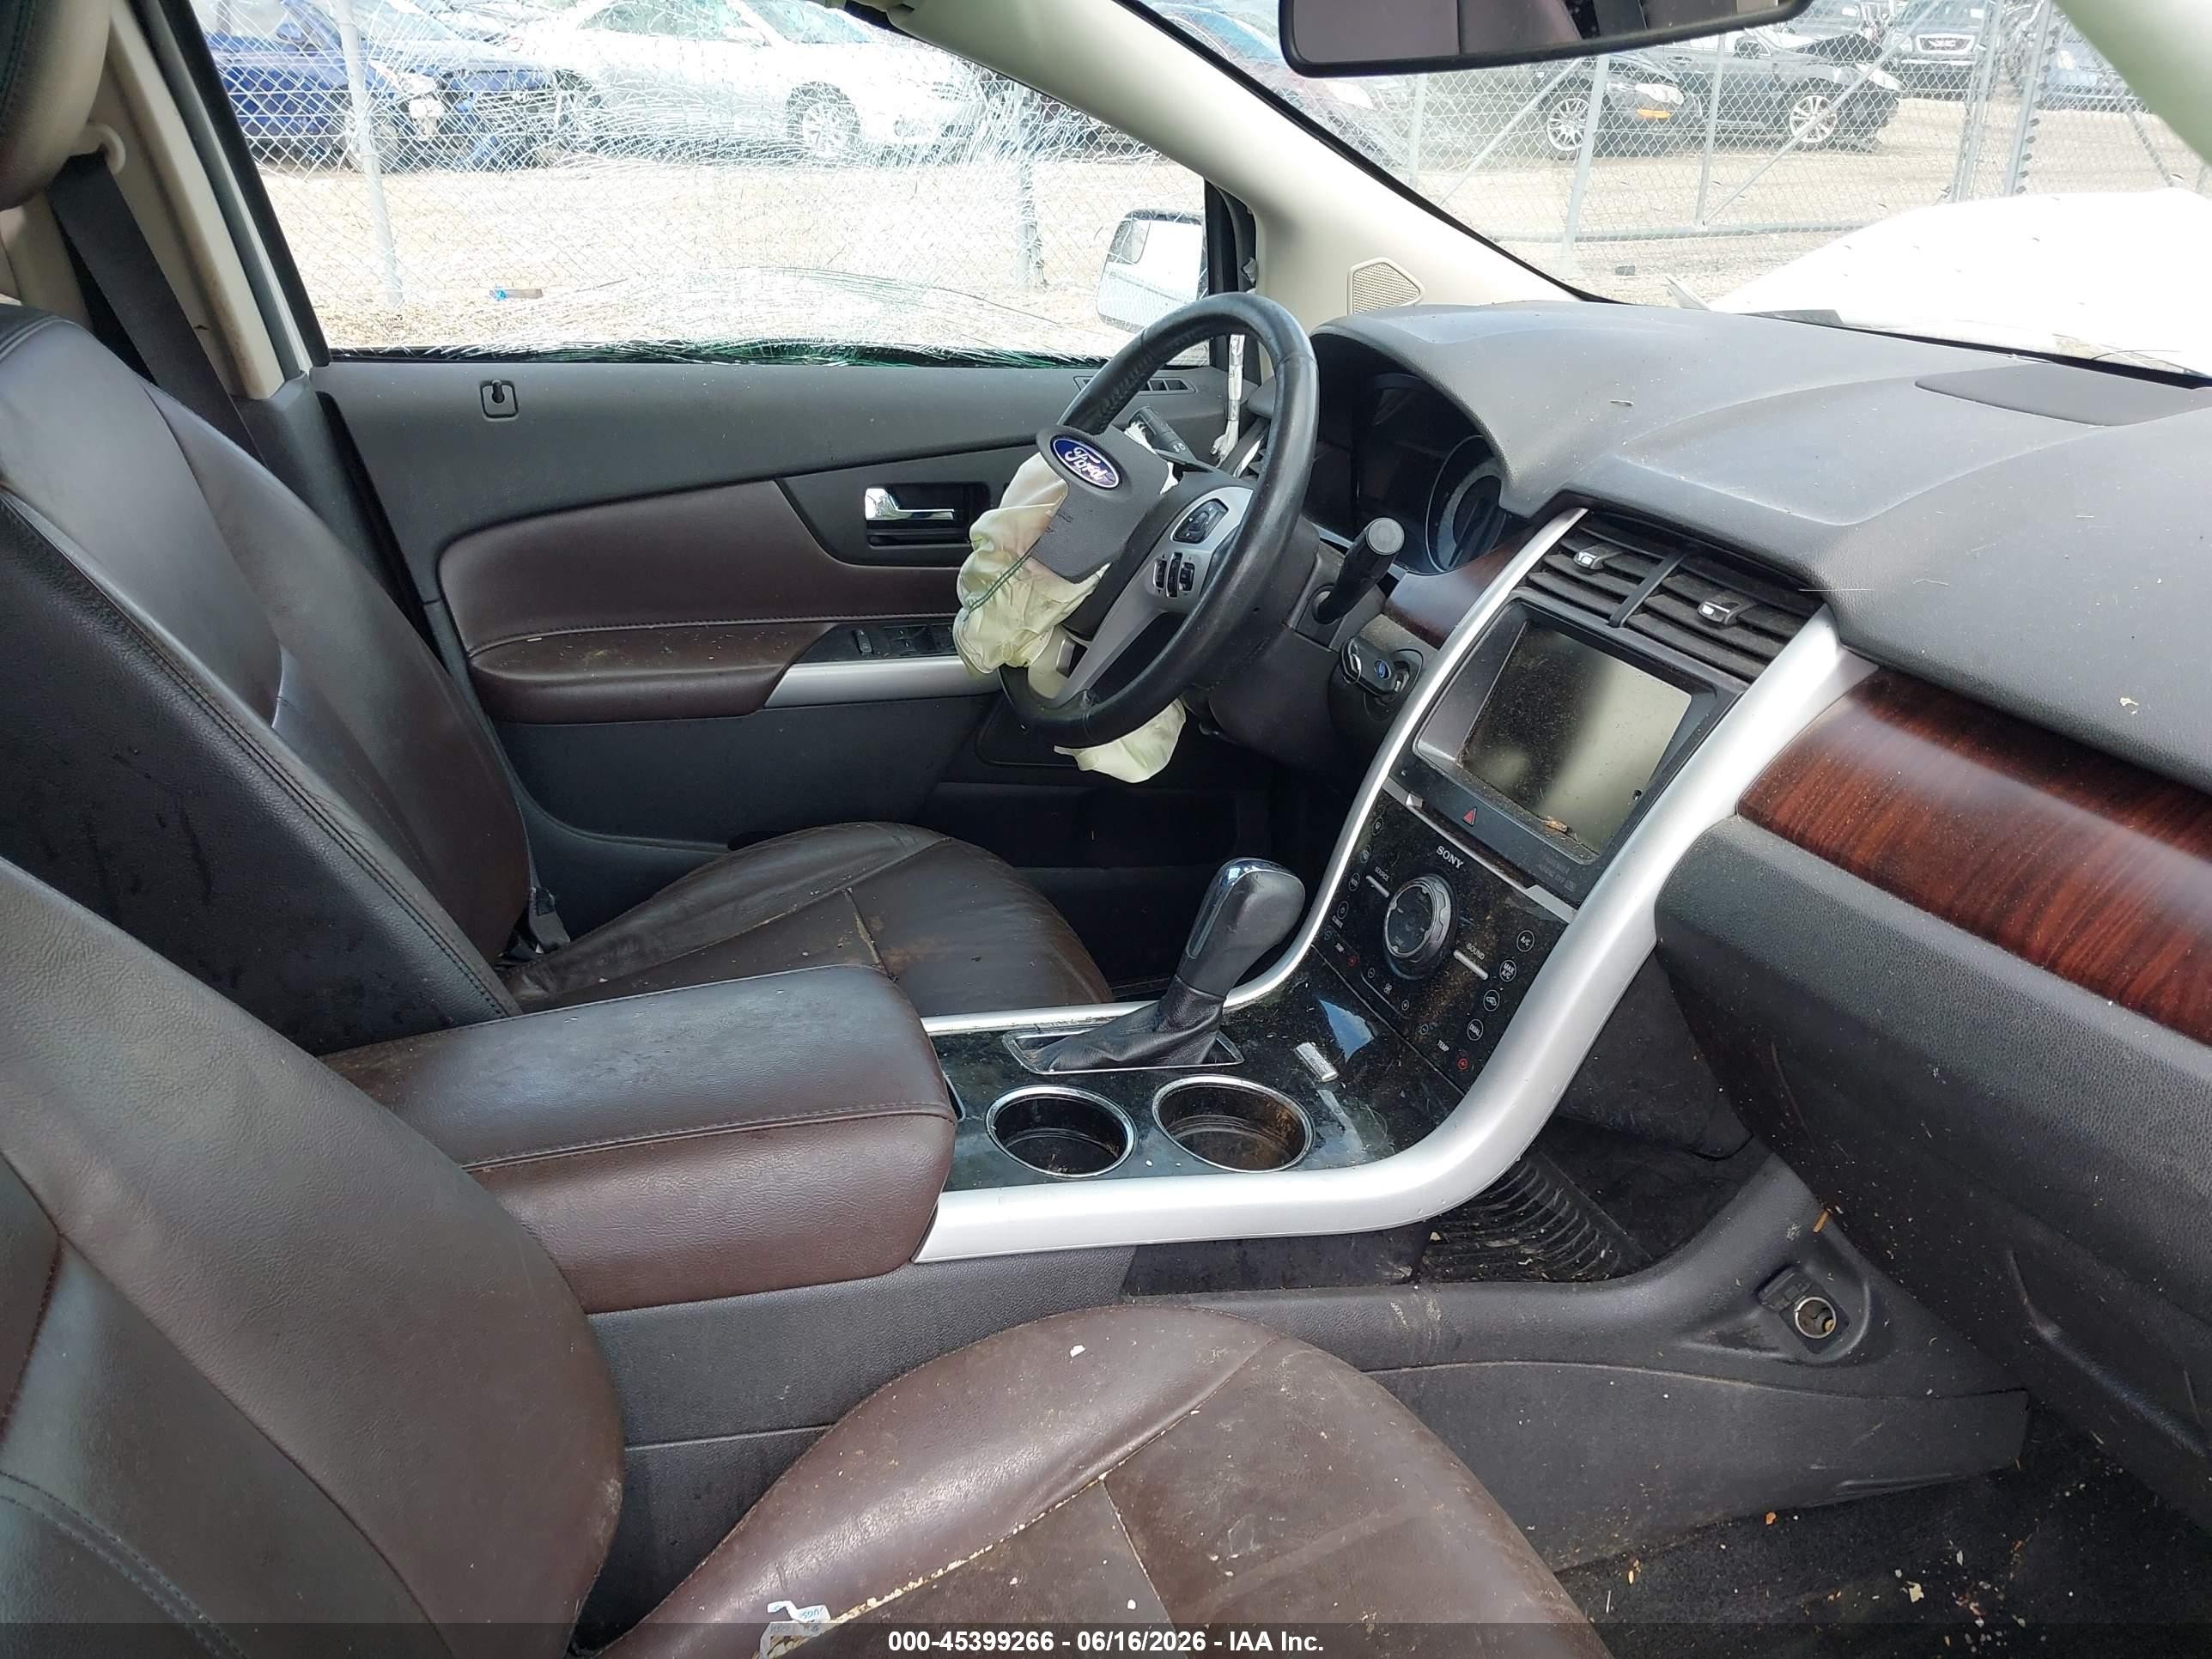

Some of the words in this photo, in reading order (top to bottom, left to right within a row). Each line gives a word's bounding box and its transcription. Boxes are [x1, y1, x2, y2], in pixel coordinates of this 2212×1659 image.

[1065, 447, 1109, 480] Ford
[1437, 845, 1464, 869] SONY
[1520, 935, 1531, 946] A/C
[1466, 943, 1486, 960] SOUND
[1503, 963, 1516, 975] MAX
[1437, 1039, 1449, 1052] TEMP
